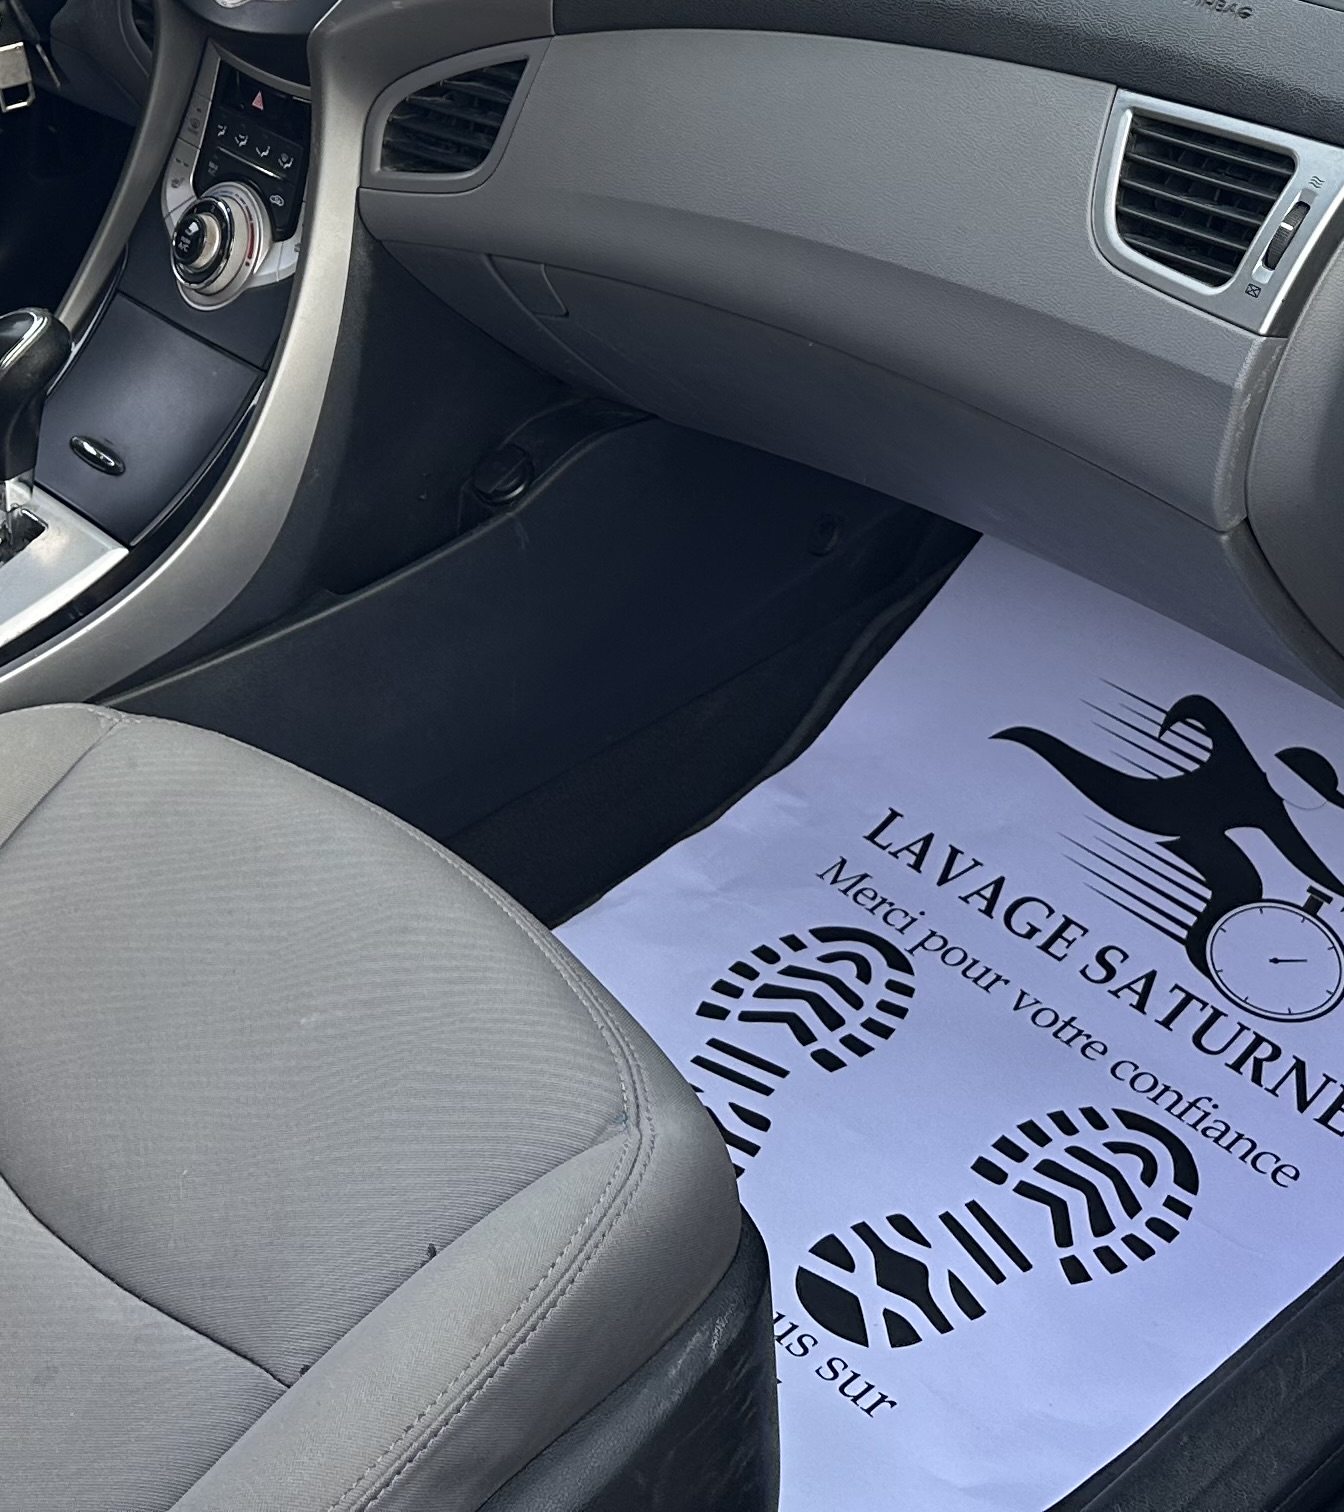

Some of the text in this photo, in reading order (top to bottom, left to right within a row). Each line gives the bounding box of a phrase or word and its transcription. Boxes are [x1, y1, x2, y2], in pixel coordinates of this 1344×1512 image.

[862, 807, 1089, 962] LAVAGE
[815, 855, 1301, 1189] Merci pour votre confiance
[815, 1357, 898, 1418] sur
